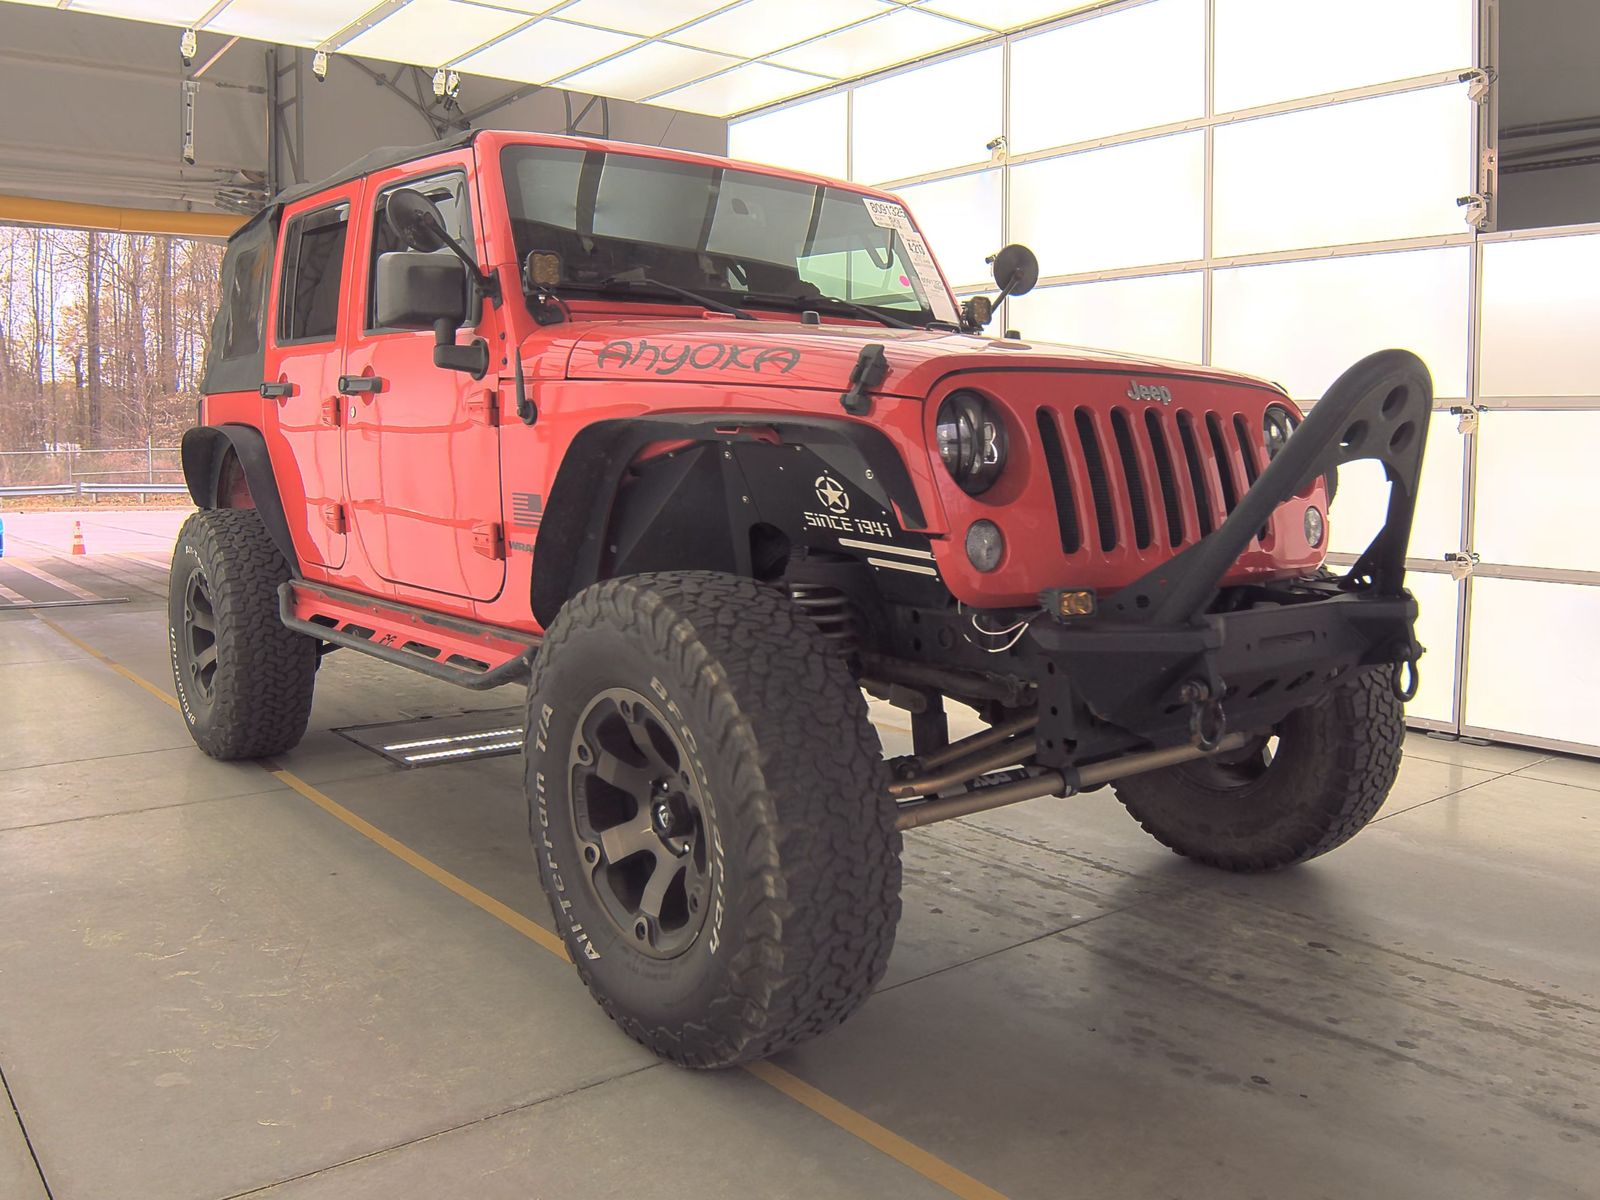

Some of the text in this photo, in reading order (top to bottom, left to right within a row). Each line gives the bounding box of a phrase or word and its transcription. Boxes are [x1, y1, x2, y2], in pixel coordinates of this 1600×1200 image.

[1127, 379, 1171, 406] Jeep
[854, 518, 893, 538] 1941
[508, 540, 535, 553] WRA
[535, 703, 553, 752] T/A
